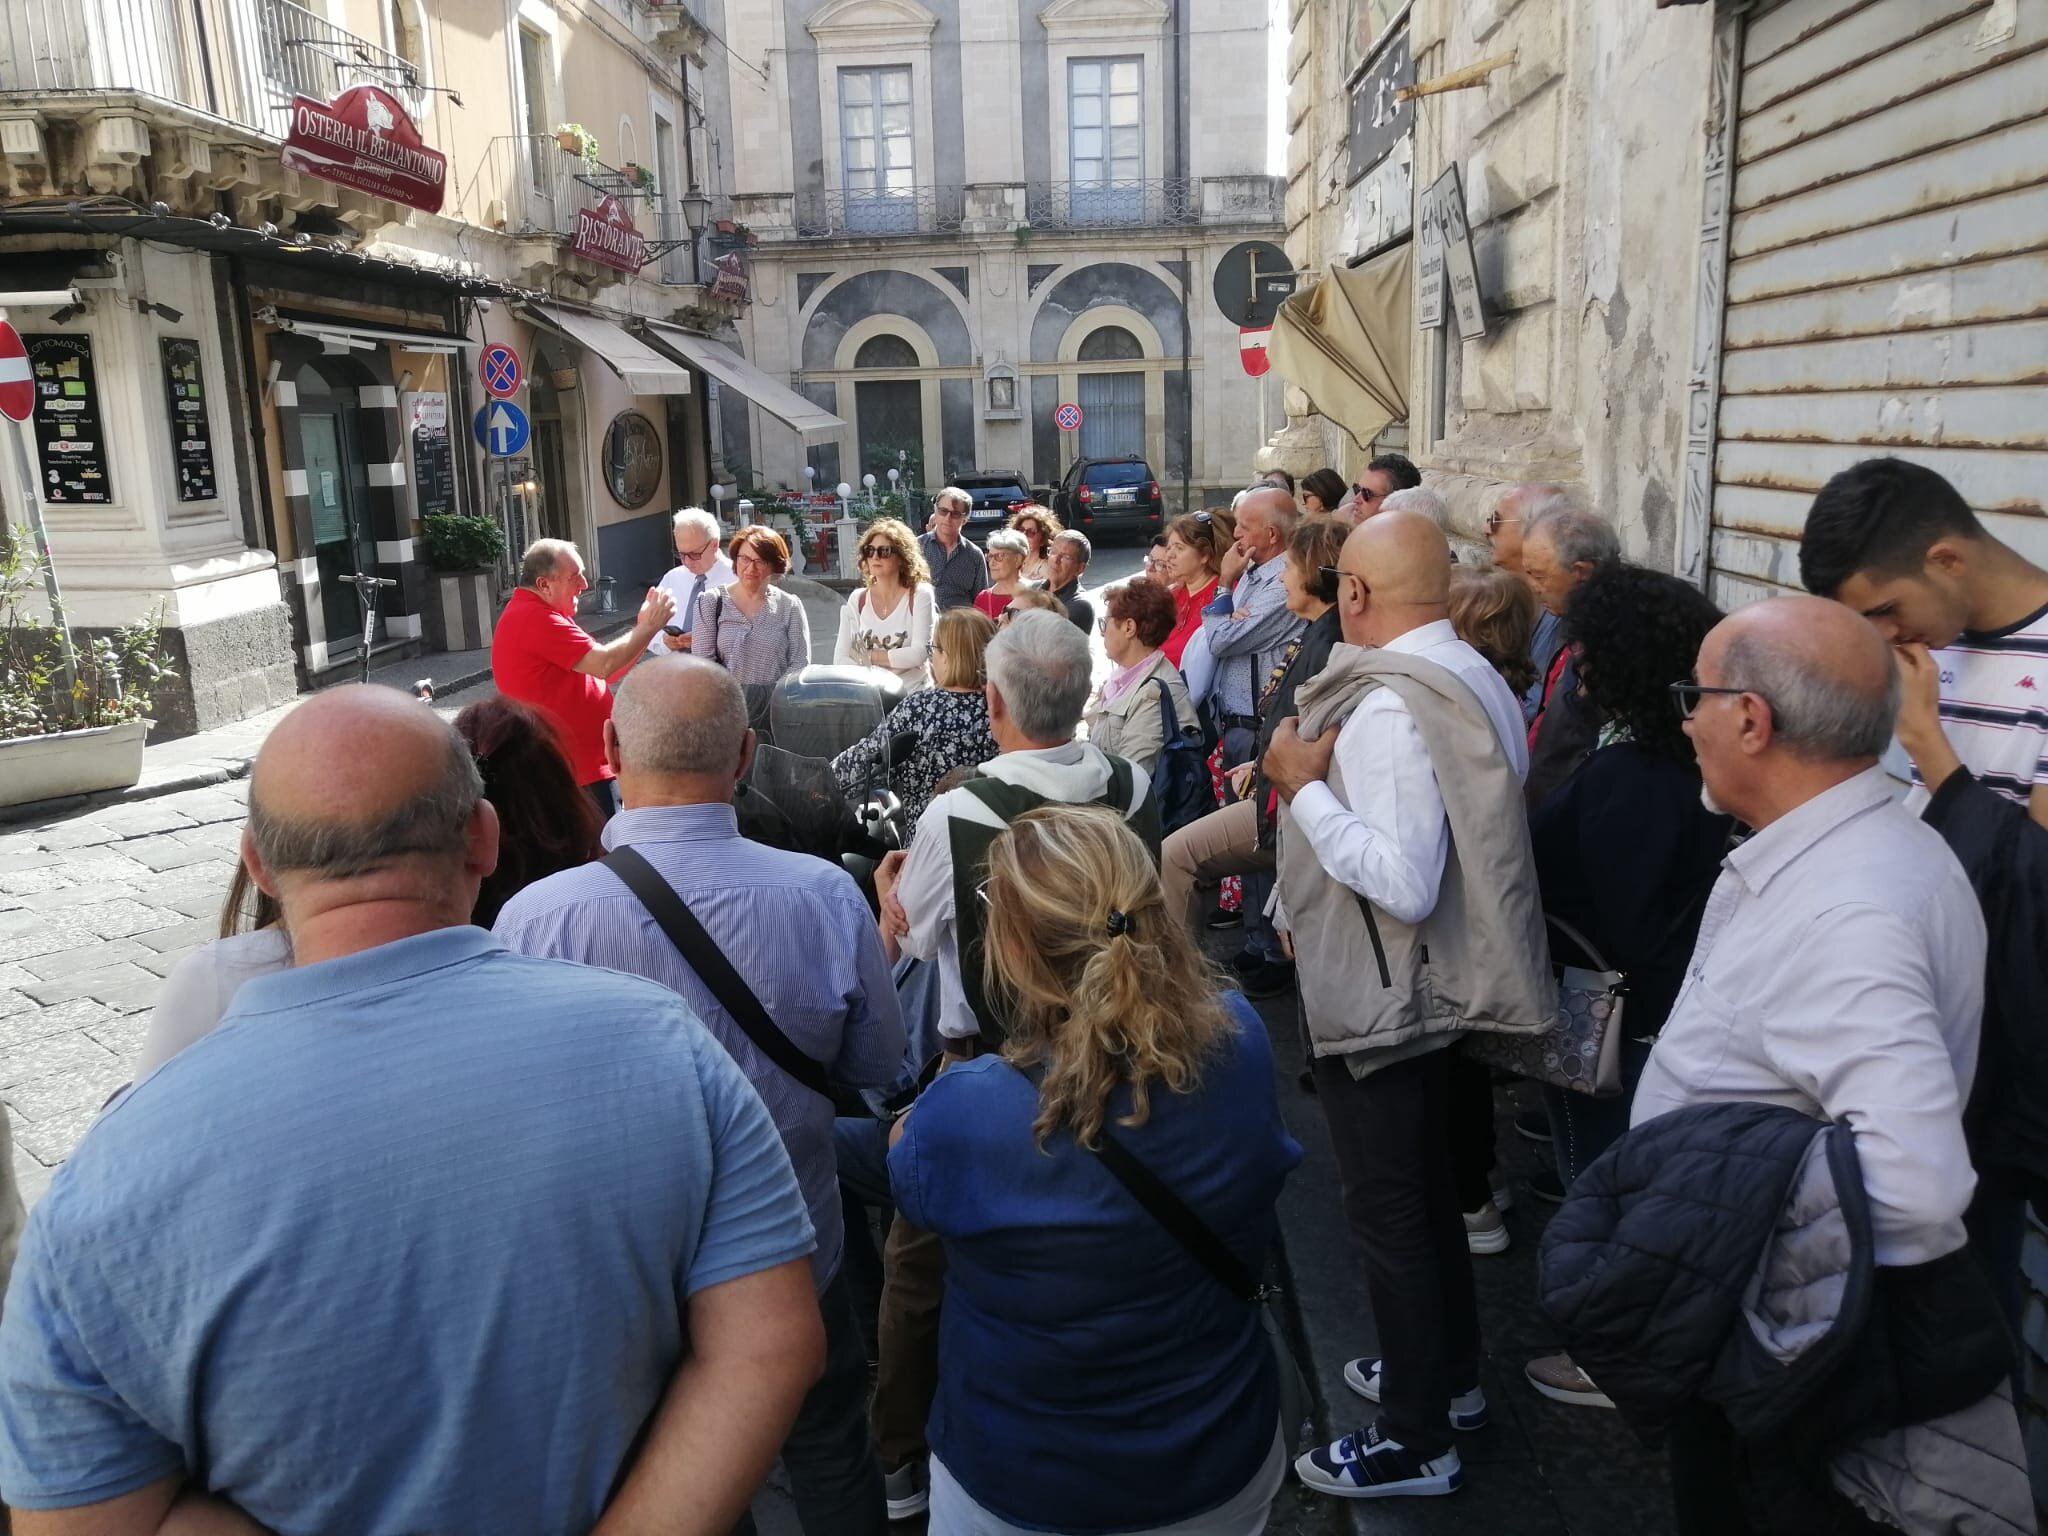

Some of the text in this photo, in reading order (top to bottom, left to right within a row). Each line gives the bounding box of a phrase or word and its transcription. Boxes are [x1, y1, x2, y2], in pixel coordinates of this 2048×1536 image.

[298, 106, 443, 184] OSTERIA IL BELL'ANTONIO
[332, 168, 355, 183] TYPICAL
[575, 214, 645, 268] RISTORANTE
[48, 469, 60, 484] 3
